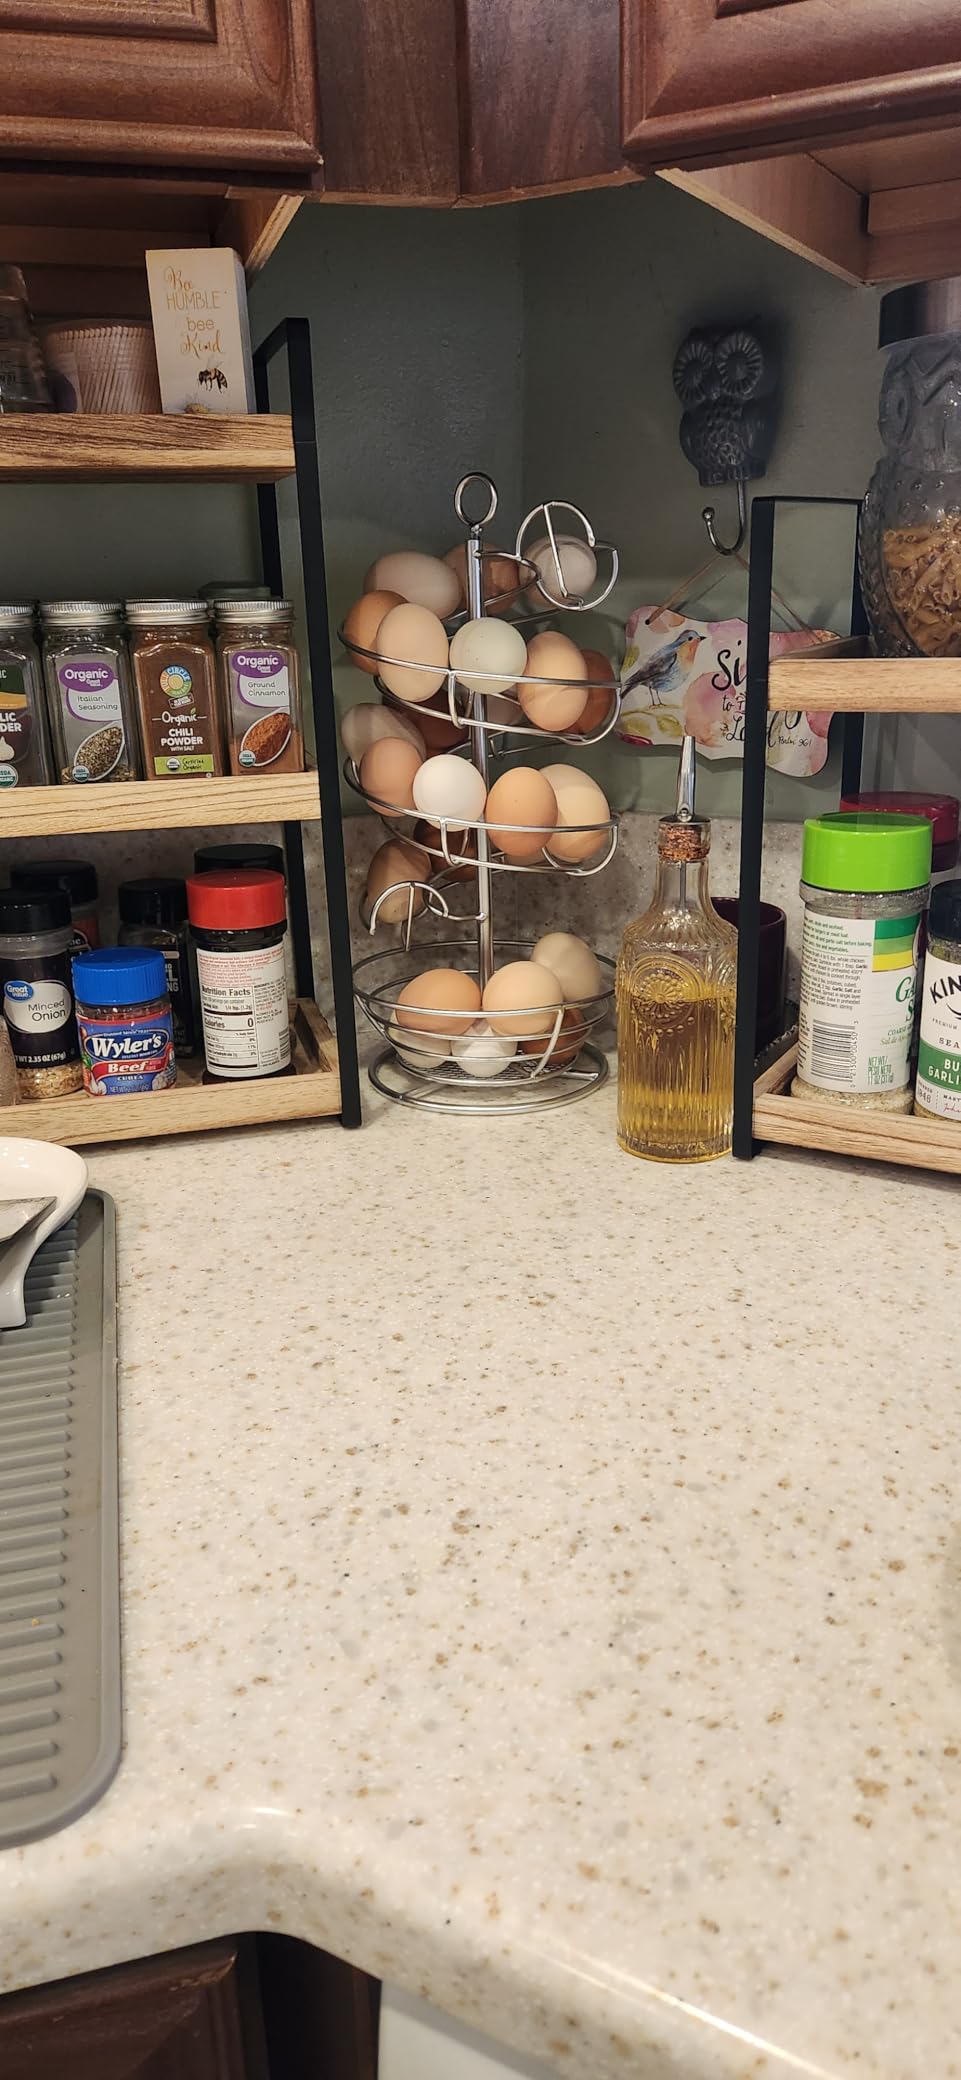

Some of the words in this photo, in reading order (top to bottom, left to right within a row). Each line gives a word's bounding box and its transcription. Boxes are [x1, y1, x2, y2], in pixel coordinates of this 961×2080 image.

[166, 290, 221, 311] HUMBLE
[187, 317, 214, 331] bee
[237, 655, 279, 668] Organic
[65, 668, 108, 682] Organic
[161, 711, 198, 726] Organic
[168, 728, 194, 737] CHILI
[161, 736, 204, 747] POWDER
[7, 984, 29, 993] Great
[201, 985, 227, 996] Nutrition
[228, 988, 251, 996] Facts
[28, 998, 65, 1012] Minced
[31, 1009, 66, 1022] Onion
[204, 1017, 225, 1028] Calories
[247, 1017, 254, 1028] 0
[91, 1033, 162, 1058] Wyler's
[28, 1055, 42, 1063] 2.35
[42, 1054, 51, 1062] OZ
[107, 1061, 149, 1073] Beef
